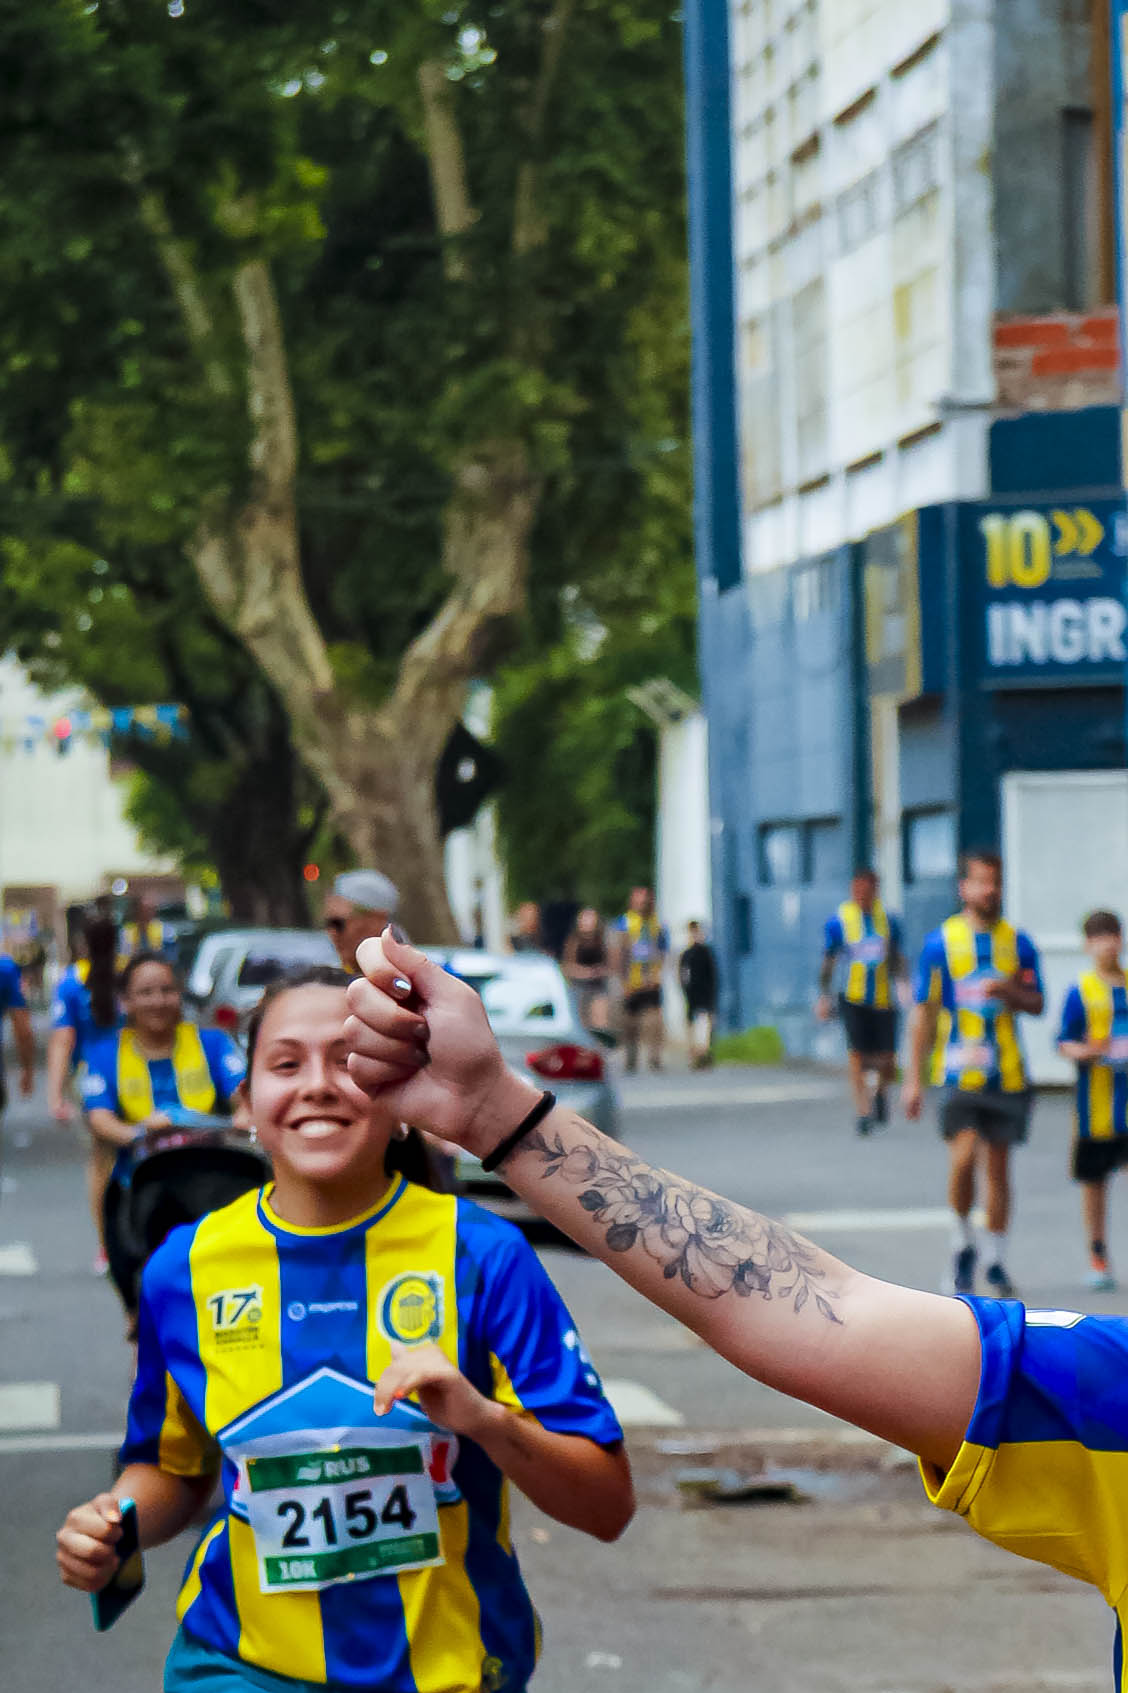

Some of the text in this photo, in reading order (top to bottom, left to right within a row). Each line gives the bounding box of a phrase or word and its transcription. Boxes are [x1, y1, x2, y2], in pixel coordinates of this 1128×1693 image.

[979, 510, 1051, 588] 10
[986, 597, 1127, 667] INGR
[209, 1287, 258, 1326] 17
[324, 1455, 370, 1477] RUS
[277, 1484, 416, 1548] 2154
